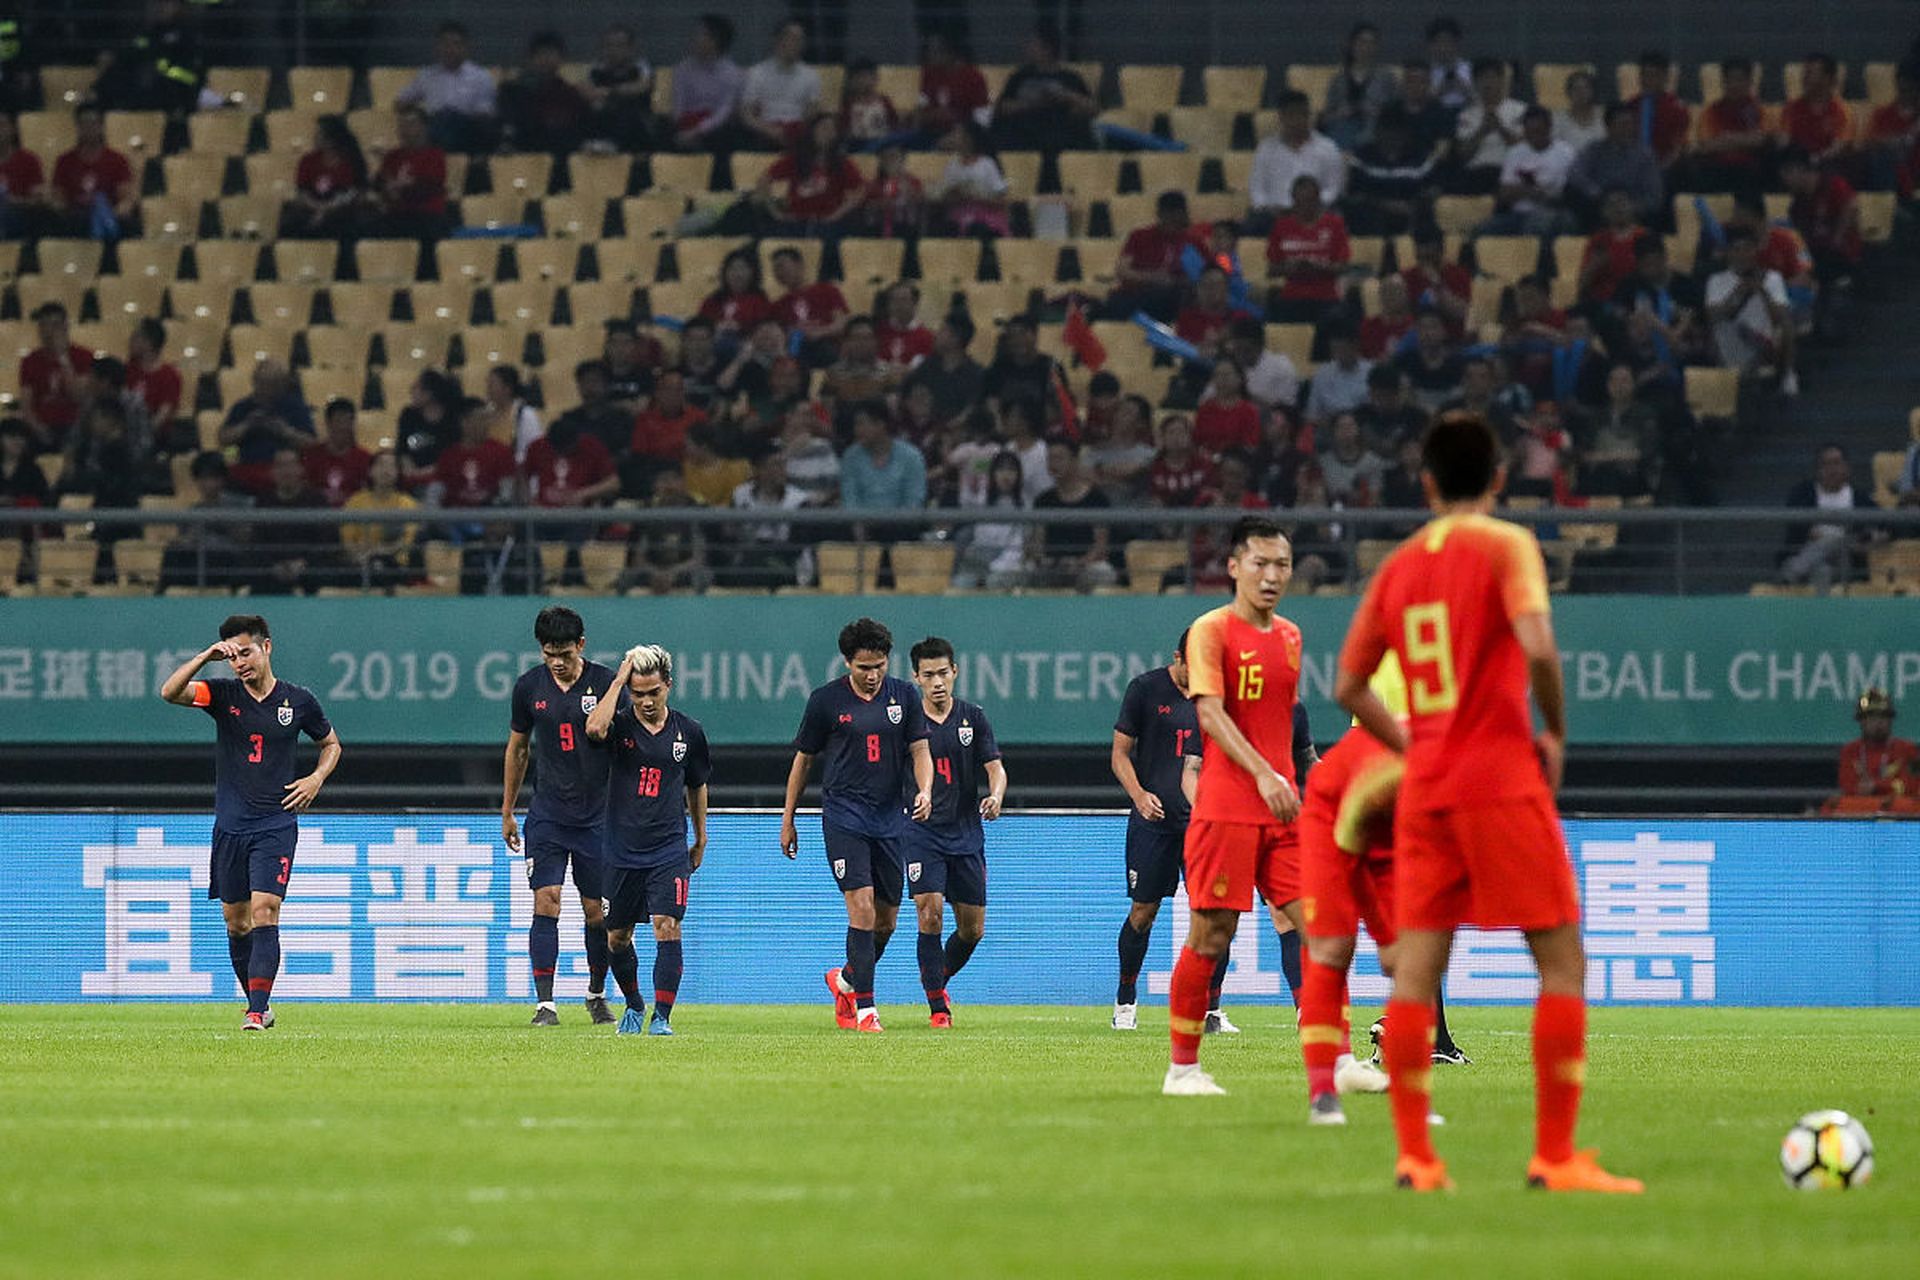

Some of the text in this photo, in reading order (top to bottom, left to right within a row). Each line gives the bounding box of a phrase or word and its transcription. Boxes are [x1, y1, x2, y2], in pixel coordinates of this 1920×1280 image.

[1403, 601, 1457, 714] 9
[328, 651, 459, 699] 2019
[675, 652, 814, 699] HINA
[1560, 652, 1713, 699] BALL
[1728, 652, 1920, 699] CHAMP
[1238, 665, 1264, 700] 15
[248, 733, 263, 763] 3
[560, 723, 573, 751] 9
[866, 734, 880, 762] 8
[1176, 729, 1192, 757] 1
[637, 766, 661, 797] 18
[936, 757, 952, 784] 4
[277, 857, 289, 885] 3
